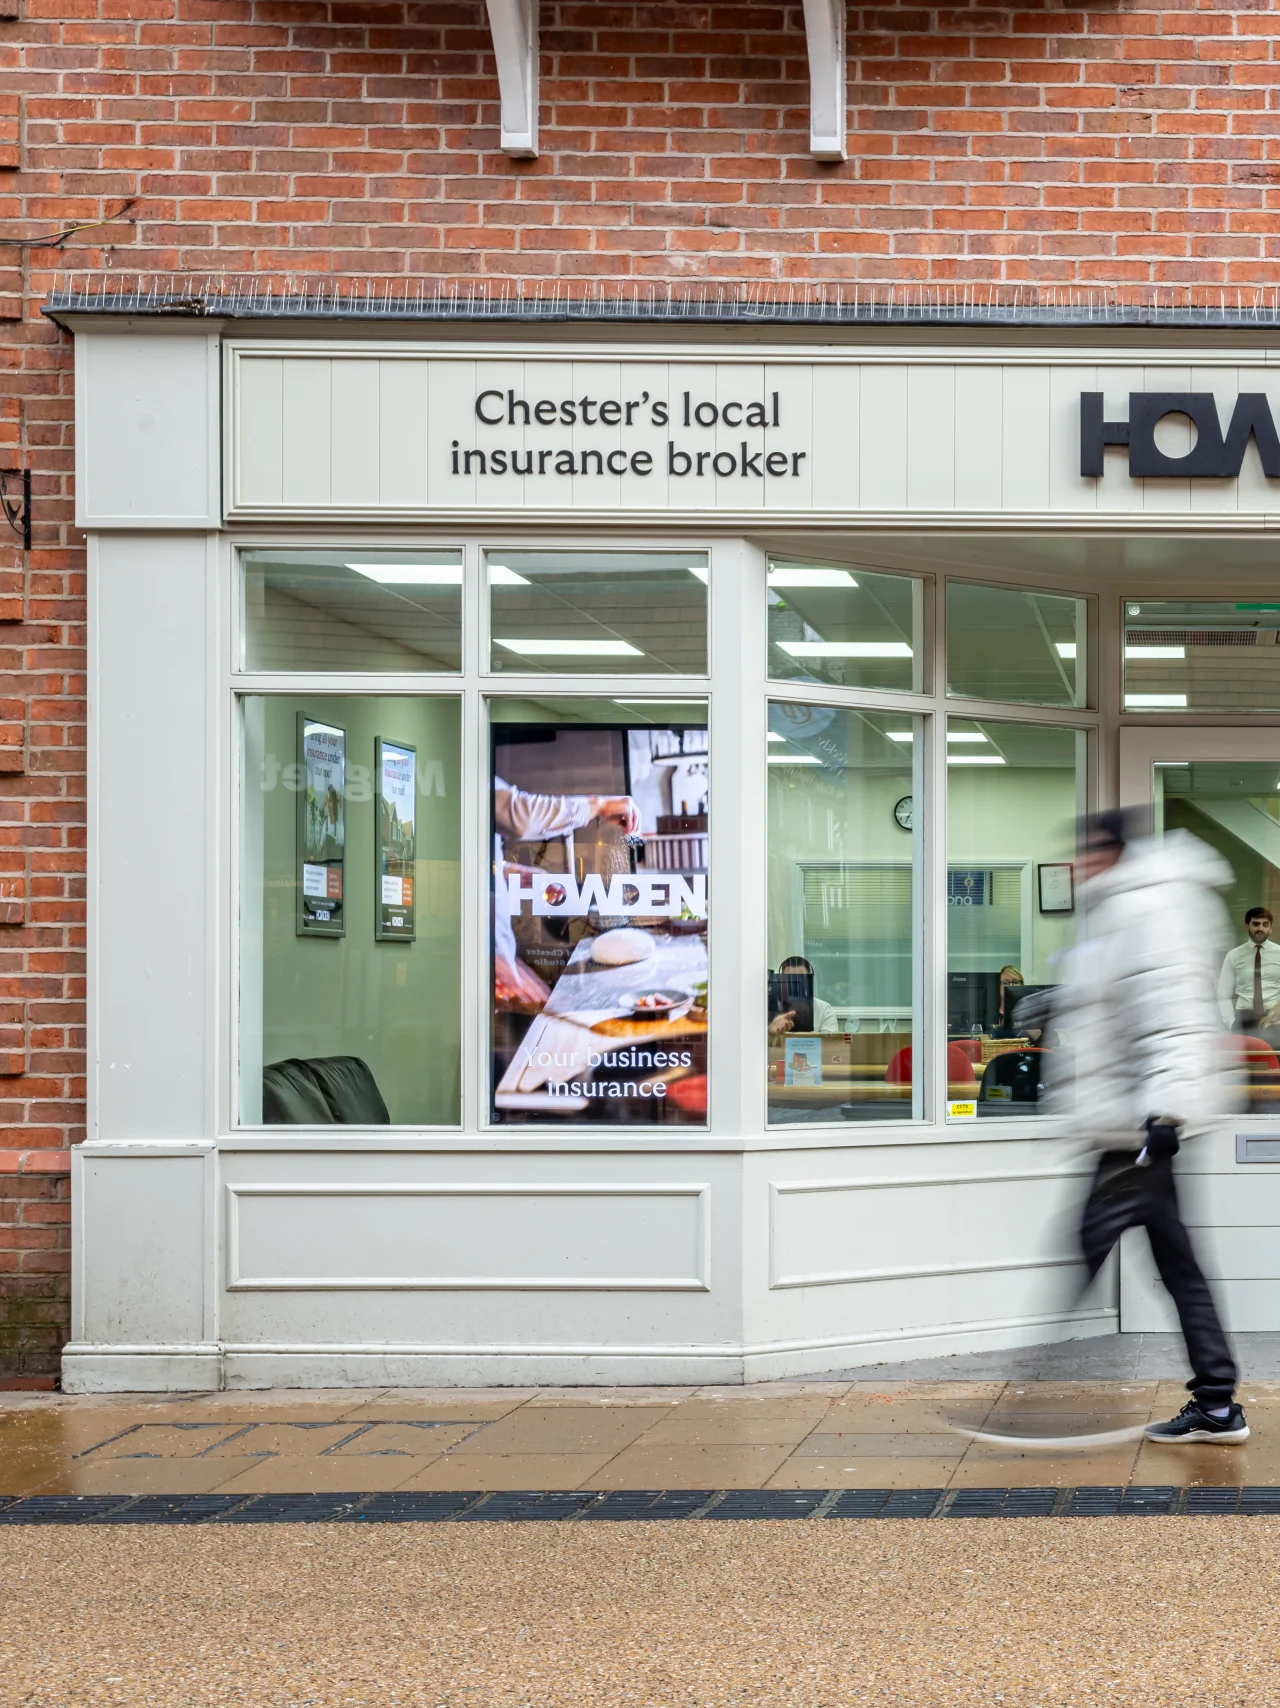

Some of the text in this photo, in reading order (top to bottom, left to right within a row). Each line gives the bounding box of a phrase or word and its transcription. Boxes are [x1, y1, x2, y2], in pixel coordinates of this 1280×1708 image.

[683, 391, 780, 427] local
[451, 440, 807, 477] insurance broker
[508, 873, 706, 916] HOWDEN
[523, 1046, 692, 1068] Your business
[547, 1076, 668, 1098] insurance
